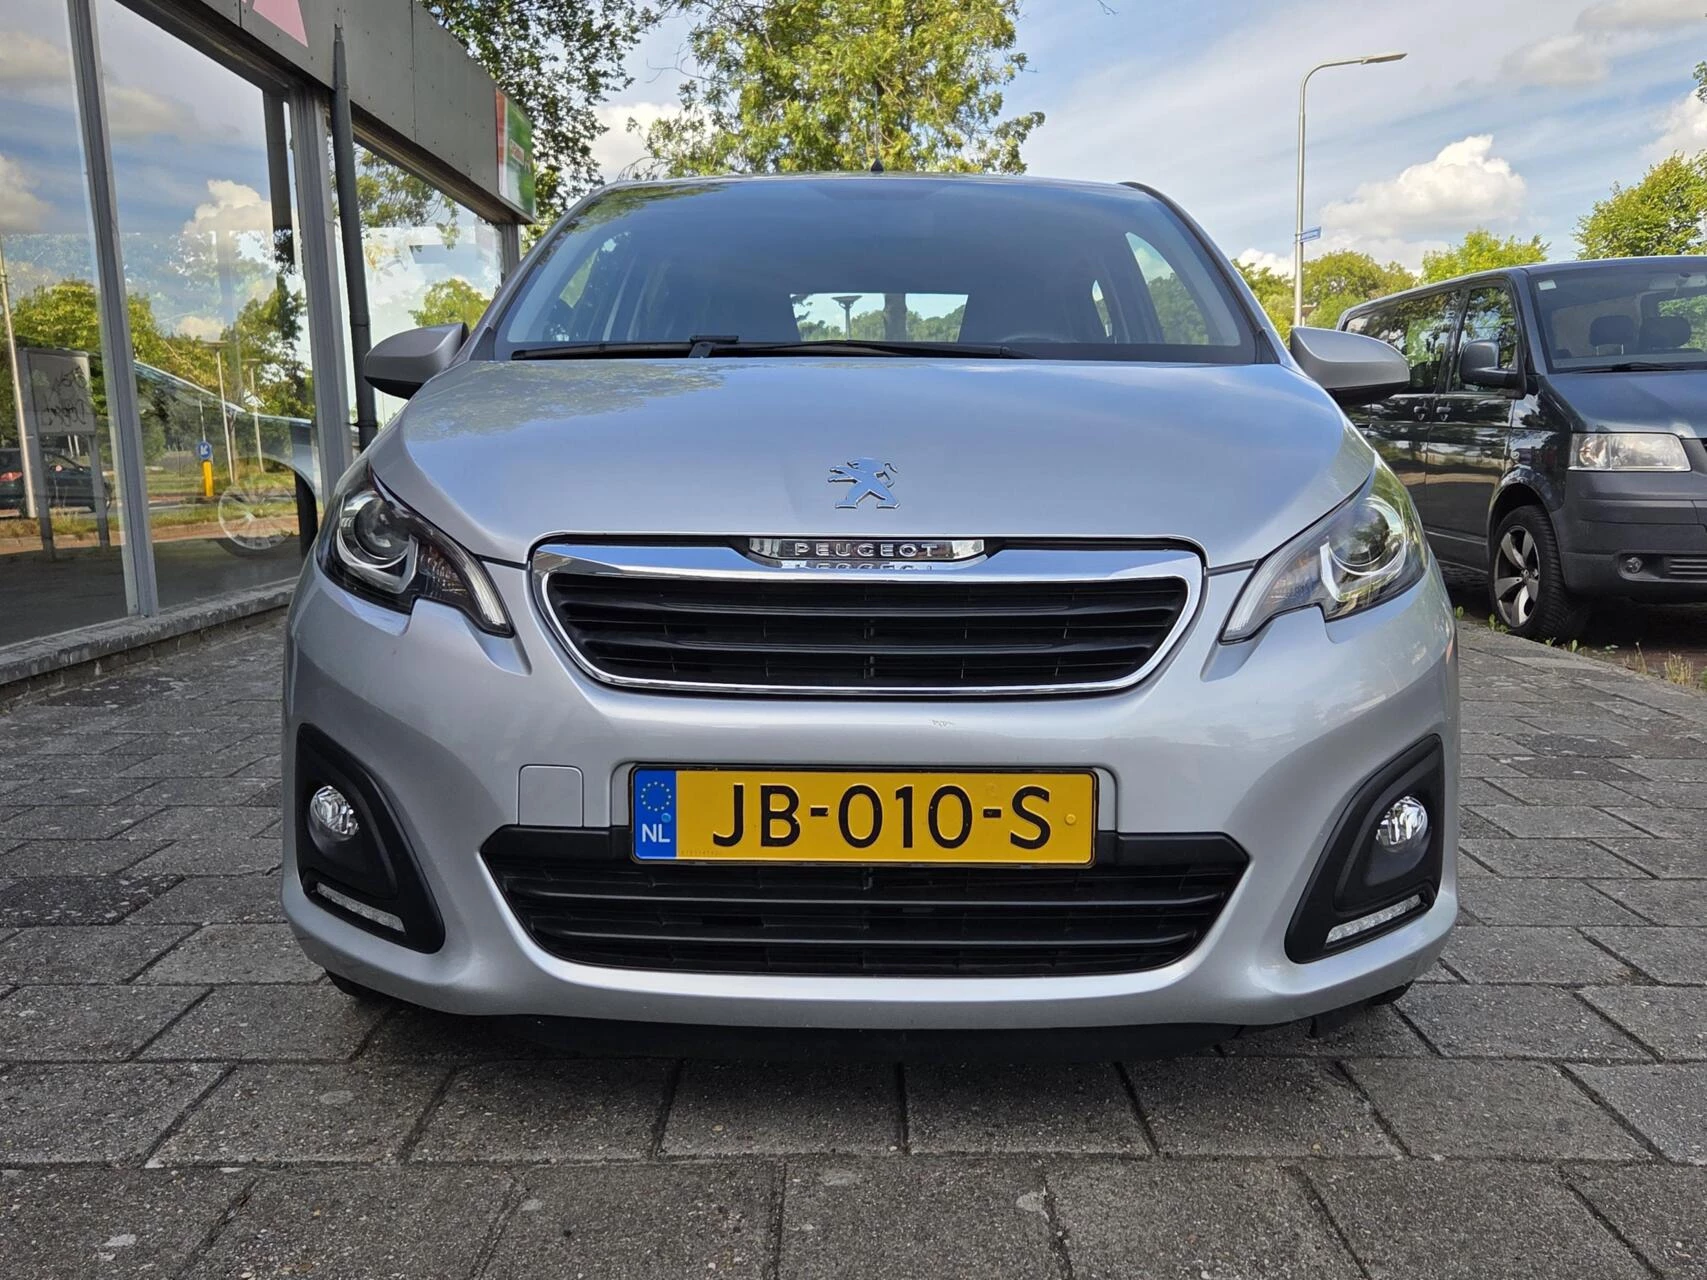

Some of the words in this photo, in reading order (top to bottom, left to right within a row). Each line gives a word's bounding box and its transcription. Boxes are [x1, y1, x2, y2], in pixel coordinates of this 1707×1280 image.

[794, 542, 938, 558] PEUGEOT
[712, 783, 1052, 850] JB-010-S
[641, 823, 670, 844] NL
